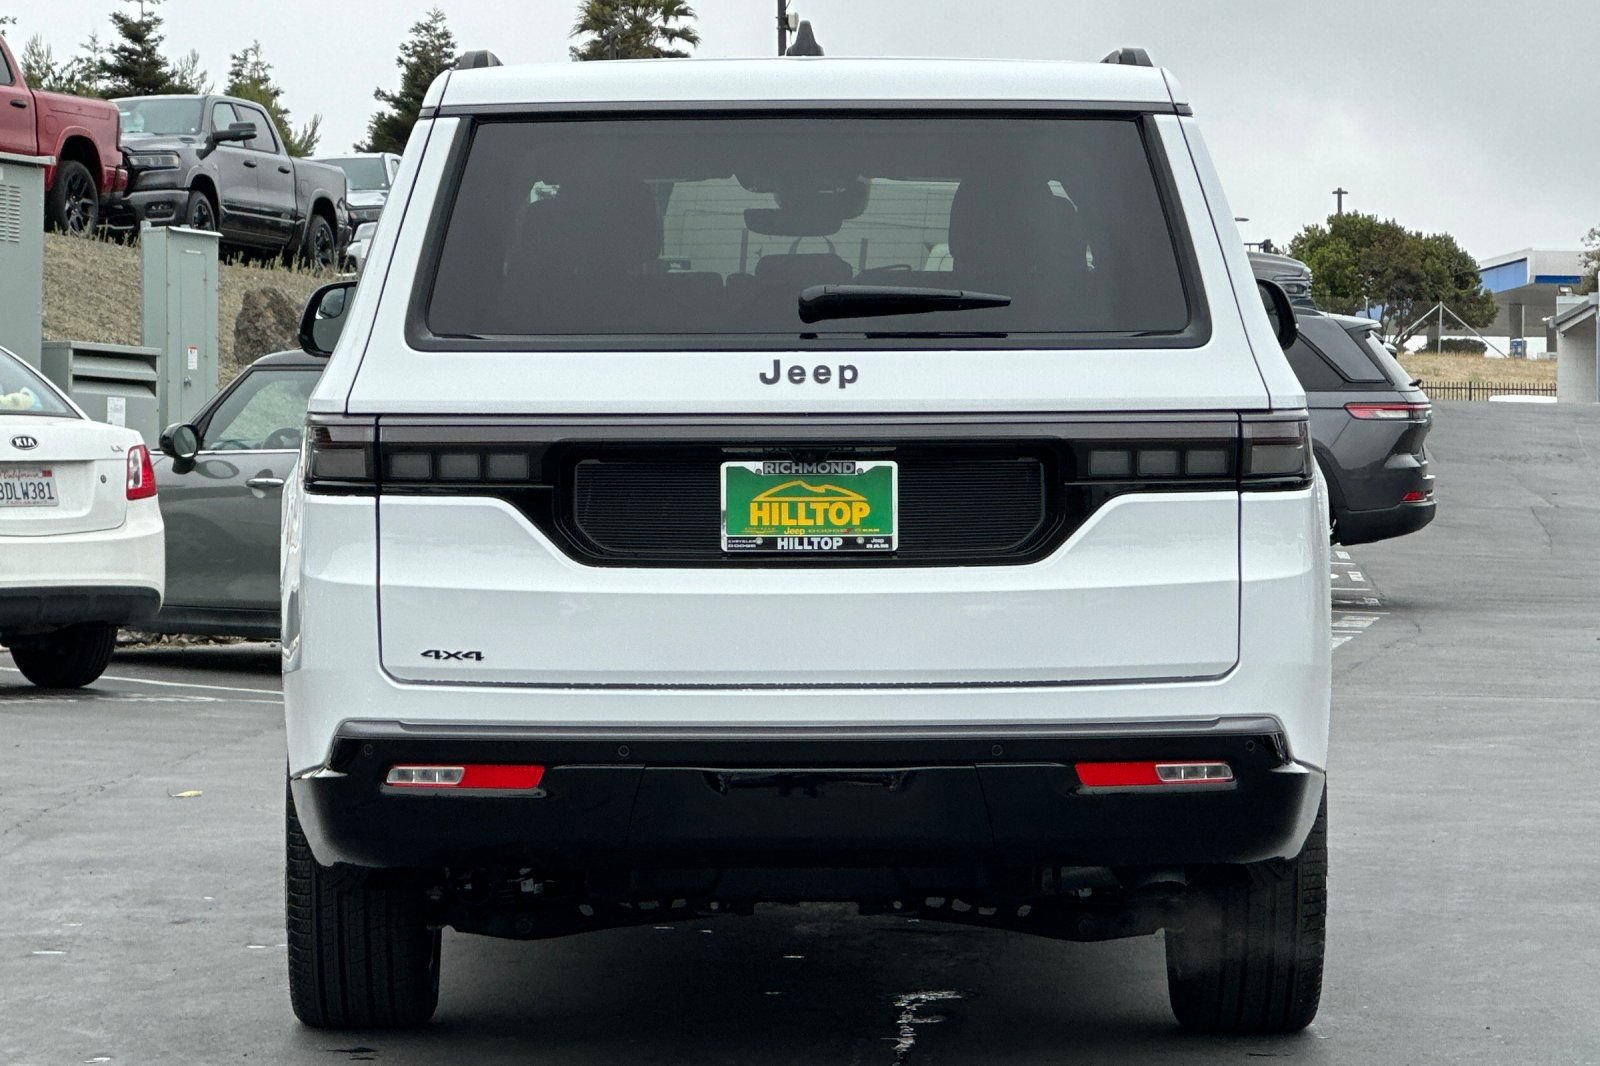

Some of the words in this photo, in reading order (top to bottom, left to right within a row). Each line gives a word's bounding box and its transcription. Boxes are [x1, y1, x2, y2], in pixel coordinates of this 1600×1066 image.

[760, 359, 859, 389] Jeep
[14, 437, 36, 447] KIA
[764, 462, 854, 474] RICHMOND
[750, 502, 871, 526] HILLTOP
[784, 527, 805, 535] Jeep
[777, 537, 843, 550] HILLTOP
[420, 649, 485, 661] 4x4
